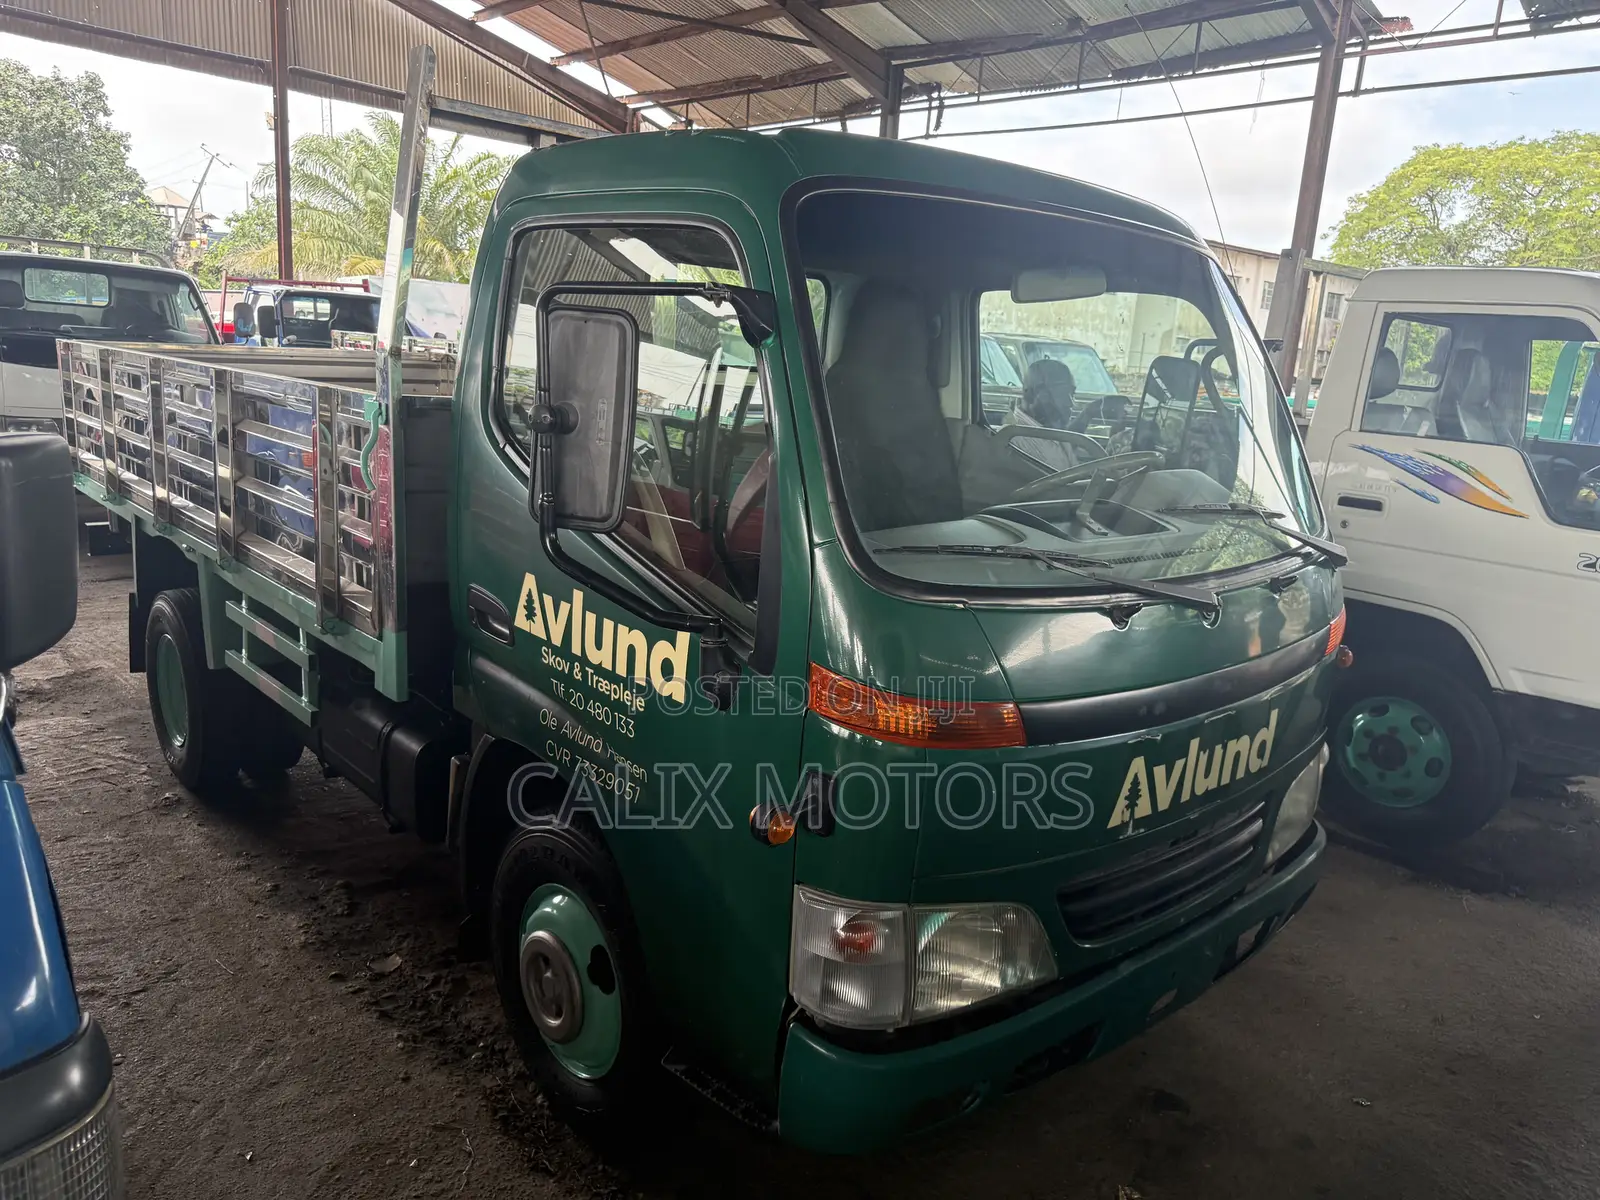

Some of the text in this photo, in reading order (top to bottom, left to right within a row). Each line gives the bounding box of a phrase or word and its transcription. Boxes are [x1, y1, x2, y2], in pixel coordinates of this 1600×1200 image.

[514, 572, 690, 704] Avlund
[541, 646, 645, 711] Skov & Træpleje
[550, 678, 635, 738] Tlf. 20 480 133
[540, 708, 558, 730] Ole
[560, 720, 603, 753] Avlund
[546, 740, 640, 803] CVR 73329051
[1107, 708, 1279, 829] Avlund
